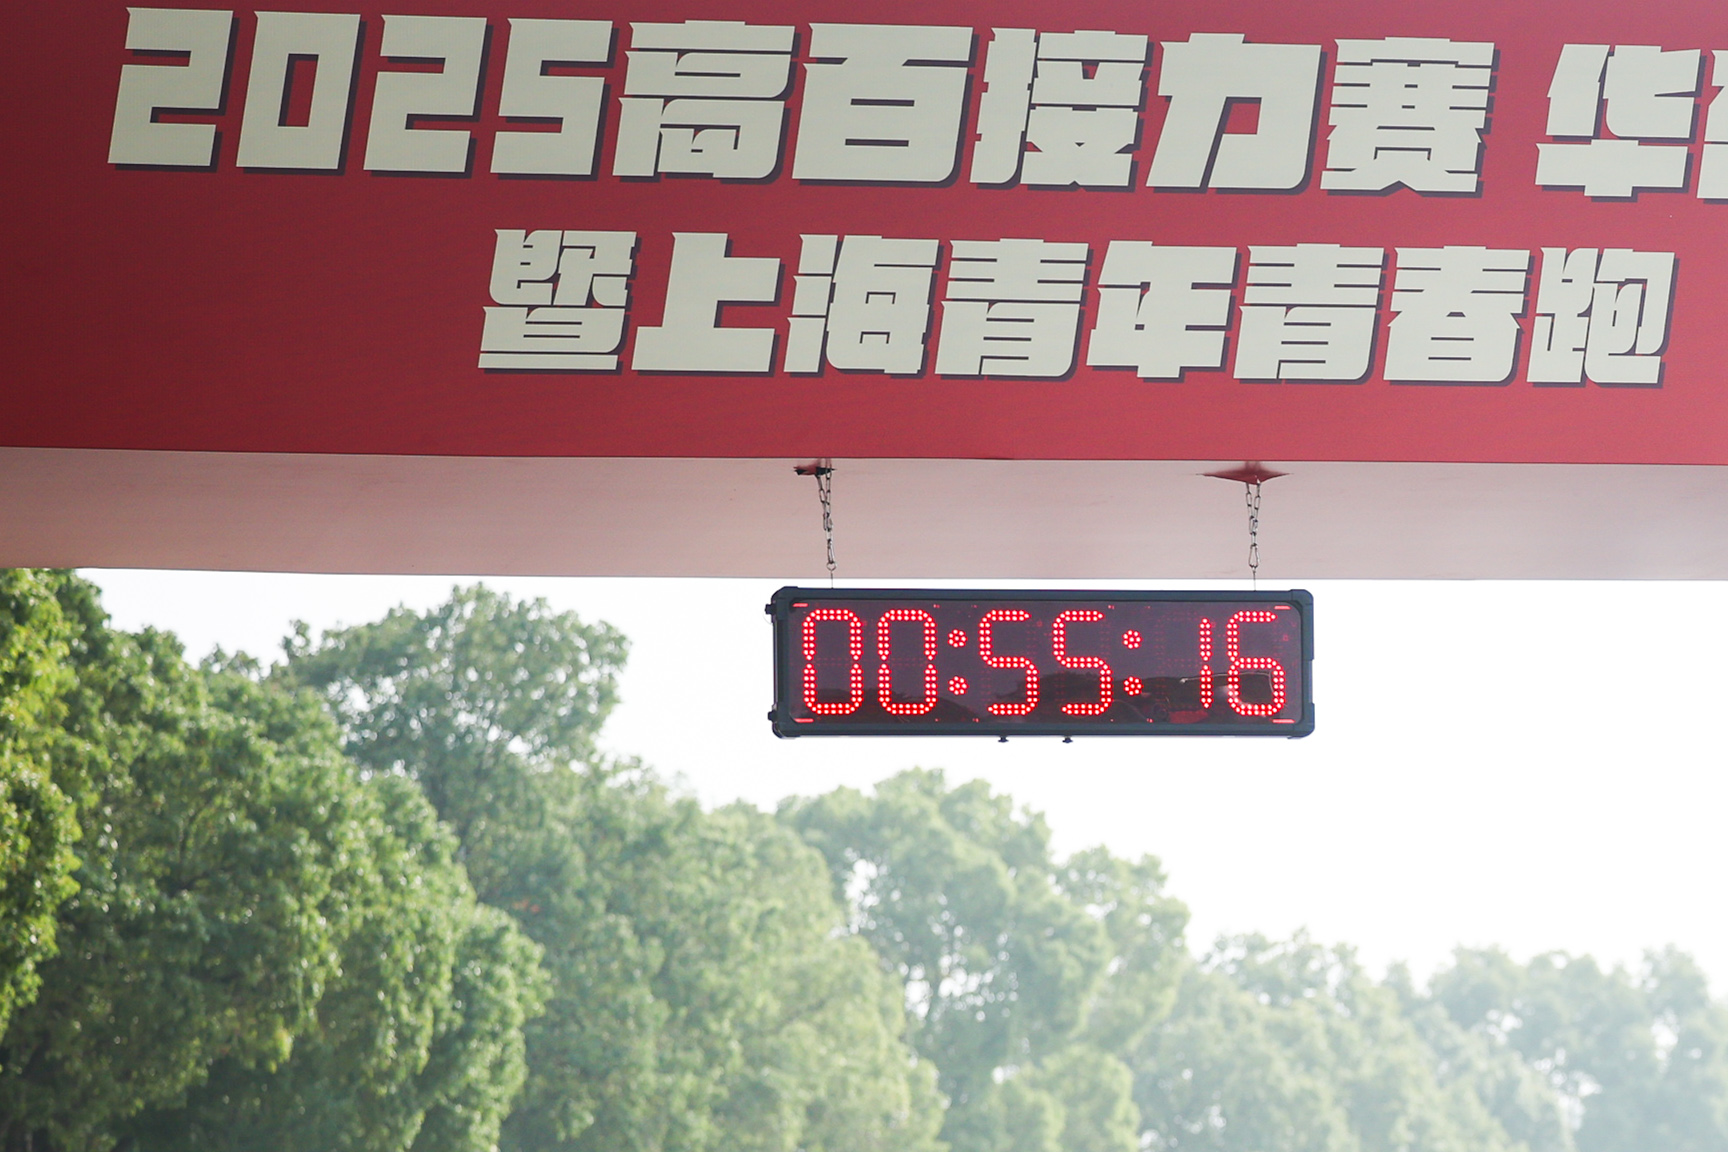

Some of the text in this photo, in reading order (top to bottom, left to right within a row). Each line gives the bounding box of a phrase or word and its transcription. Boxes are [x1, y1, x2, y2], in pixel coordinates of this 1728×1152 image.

[107, 6, 1496, 197] 2025高百接力赛
[477, 228, 1678, 386] 暨上海青年青春跑
[802, 608, 1286, 716] 00:55:16
